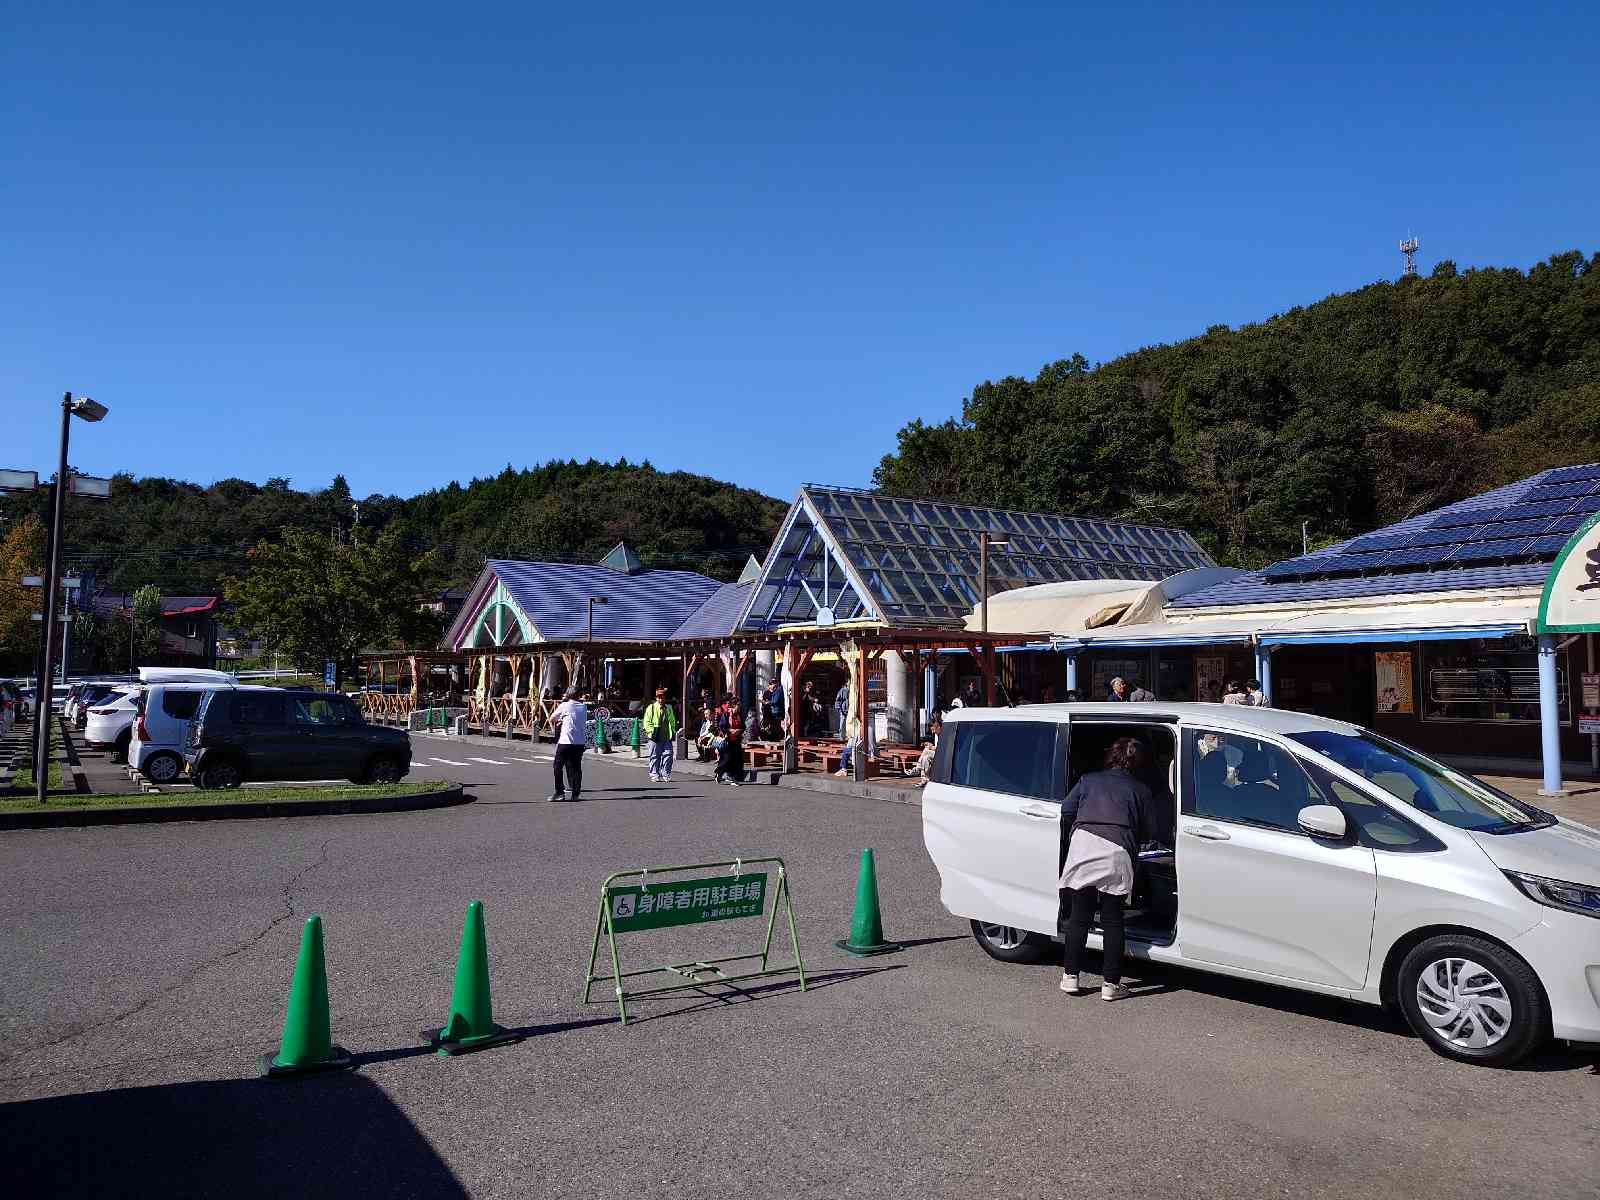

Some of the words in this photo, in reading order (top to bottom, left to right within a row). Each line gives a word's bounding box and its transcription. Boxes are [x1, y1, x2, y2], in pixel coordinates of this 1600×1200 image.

[637, 881, 761, 913] 身障者用駐車場
